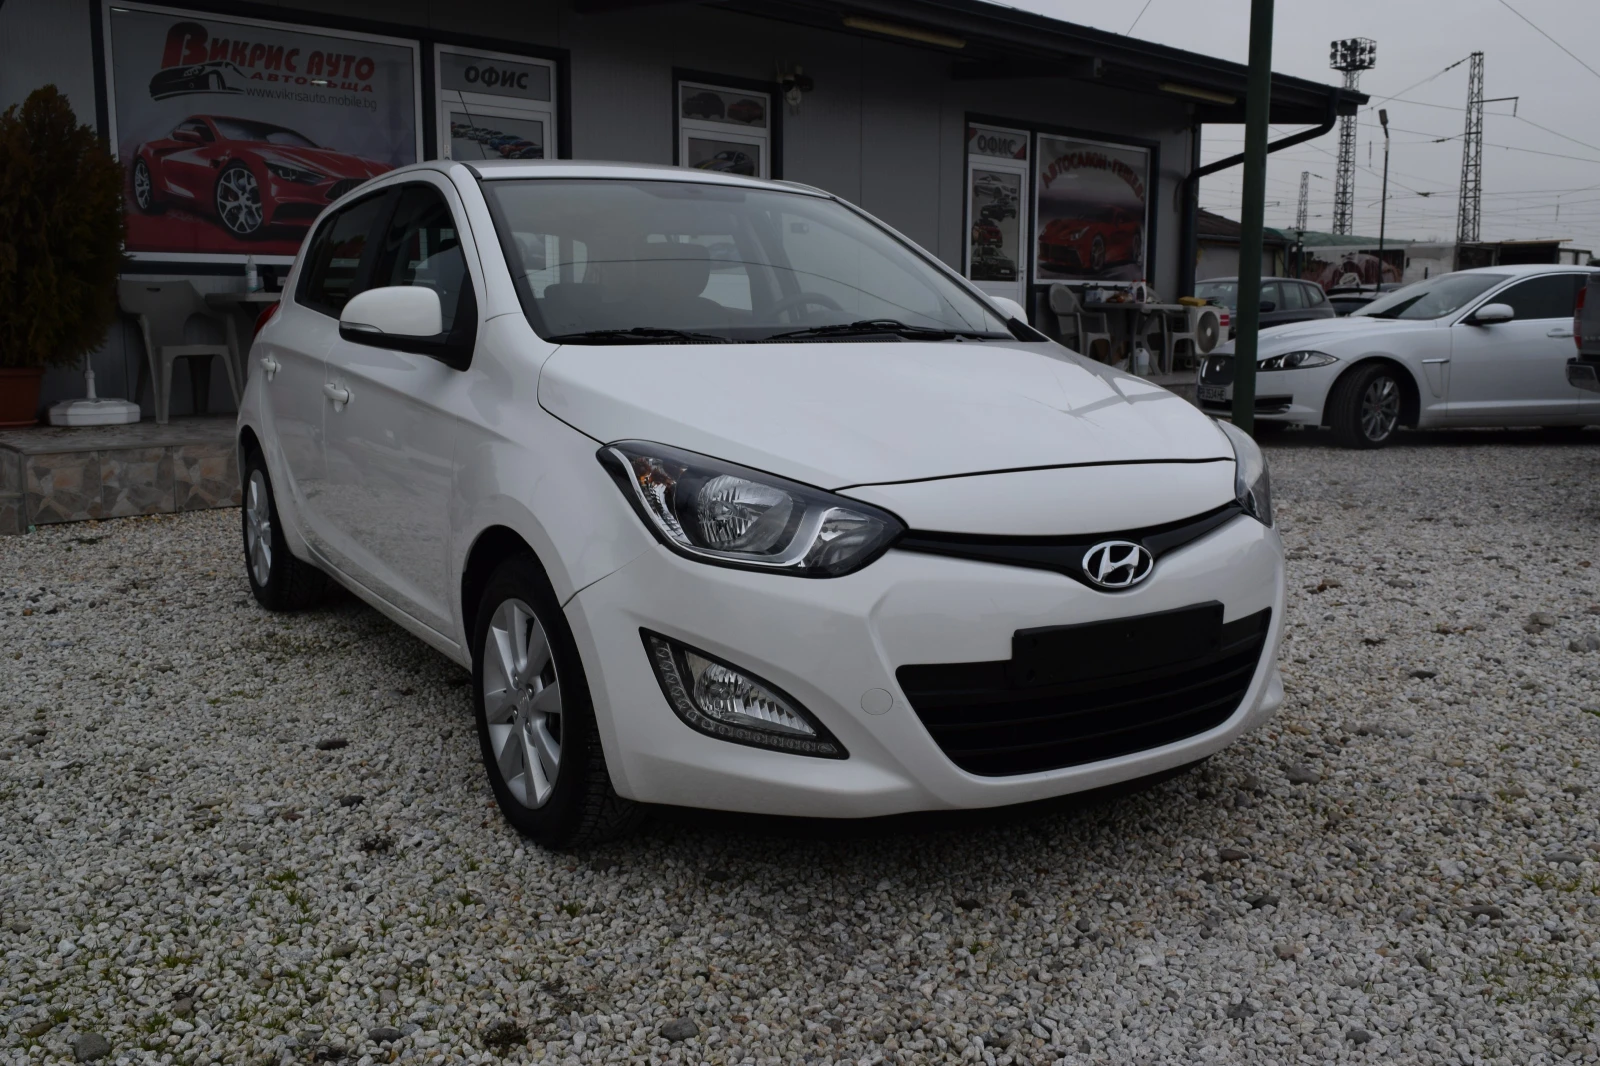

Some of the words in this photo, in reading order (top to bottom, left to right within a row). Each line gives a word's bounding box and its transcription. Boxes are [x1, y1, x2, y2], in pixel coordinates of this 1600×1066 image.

[307, 51, 376, 81] АУТО
[464, 66, 530, 89] ОФИС
[246, 86, 378, 111] www.vikrisauto.mobile.bg
[977, 135, 1017, 156] ОФИС
